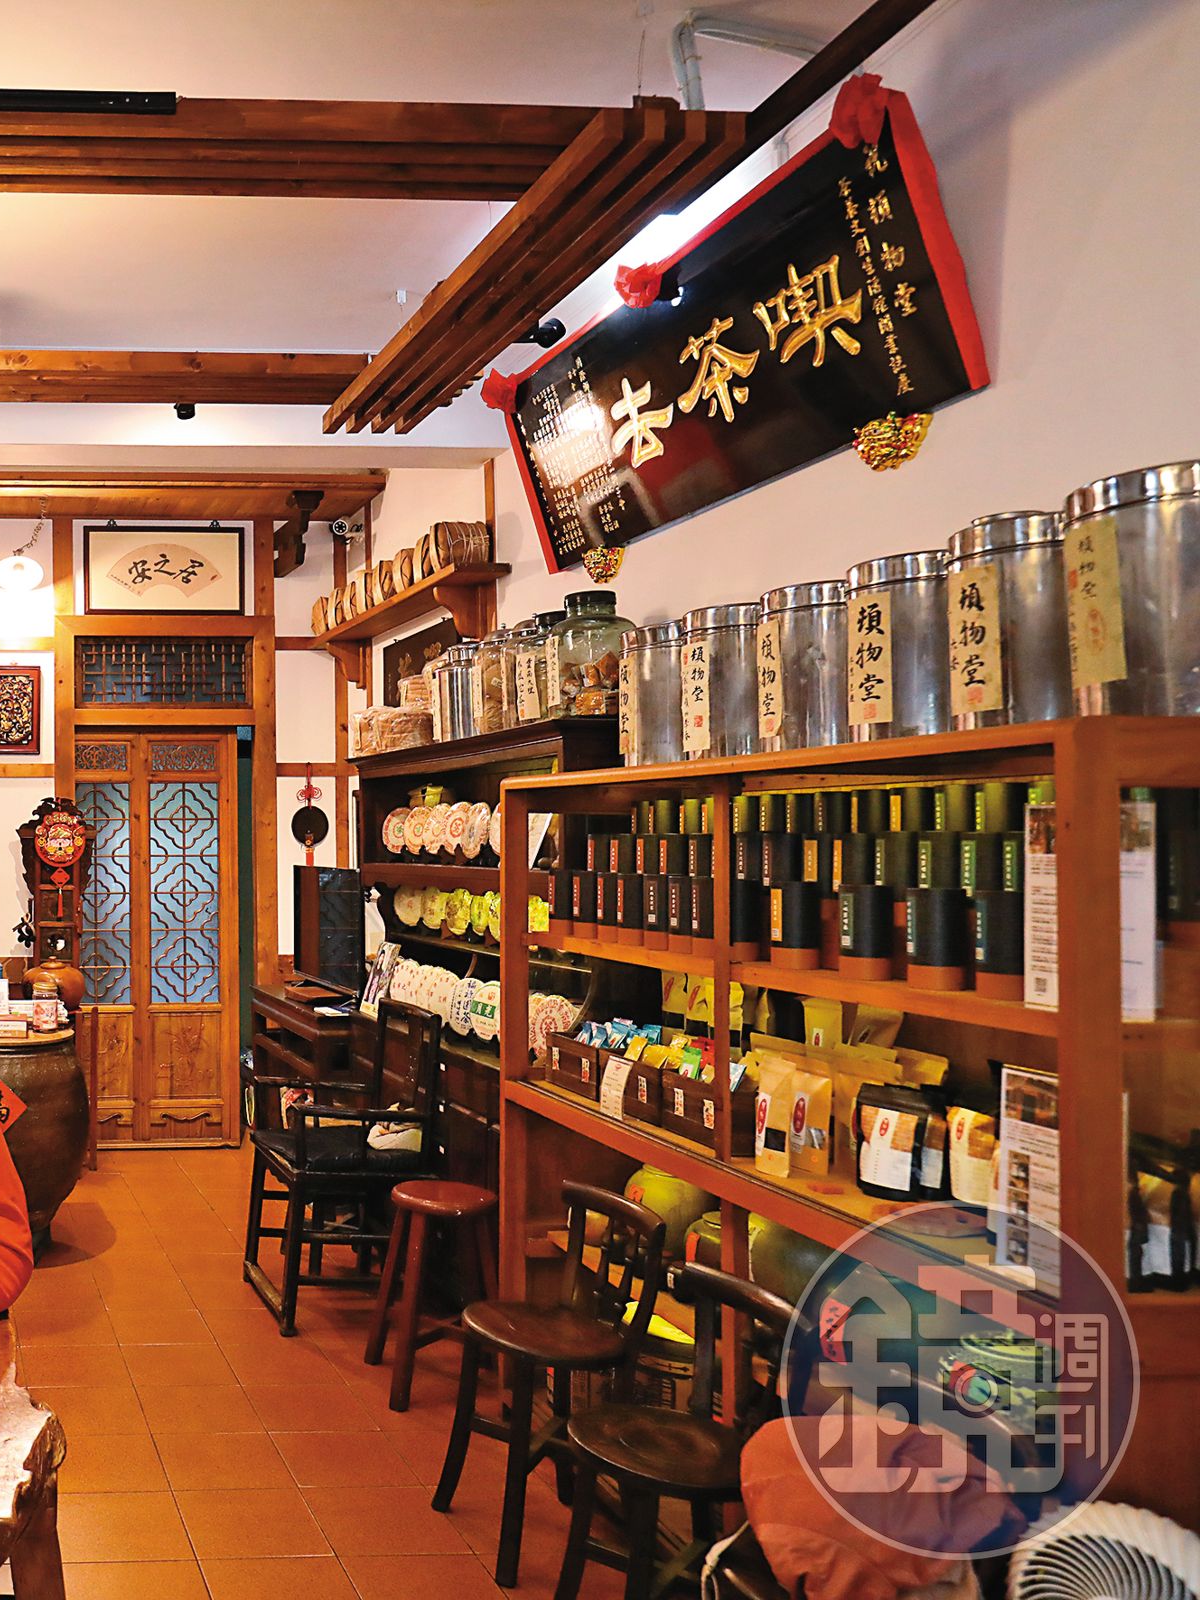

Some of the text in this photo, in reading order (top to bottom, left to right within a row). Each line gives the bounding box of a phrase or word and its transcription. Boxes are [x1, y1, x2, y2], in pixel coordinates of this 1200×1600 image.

[610, 253, 862, 469] 喫茶去
[128, 553, 204, 585] 居之安
